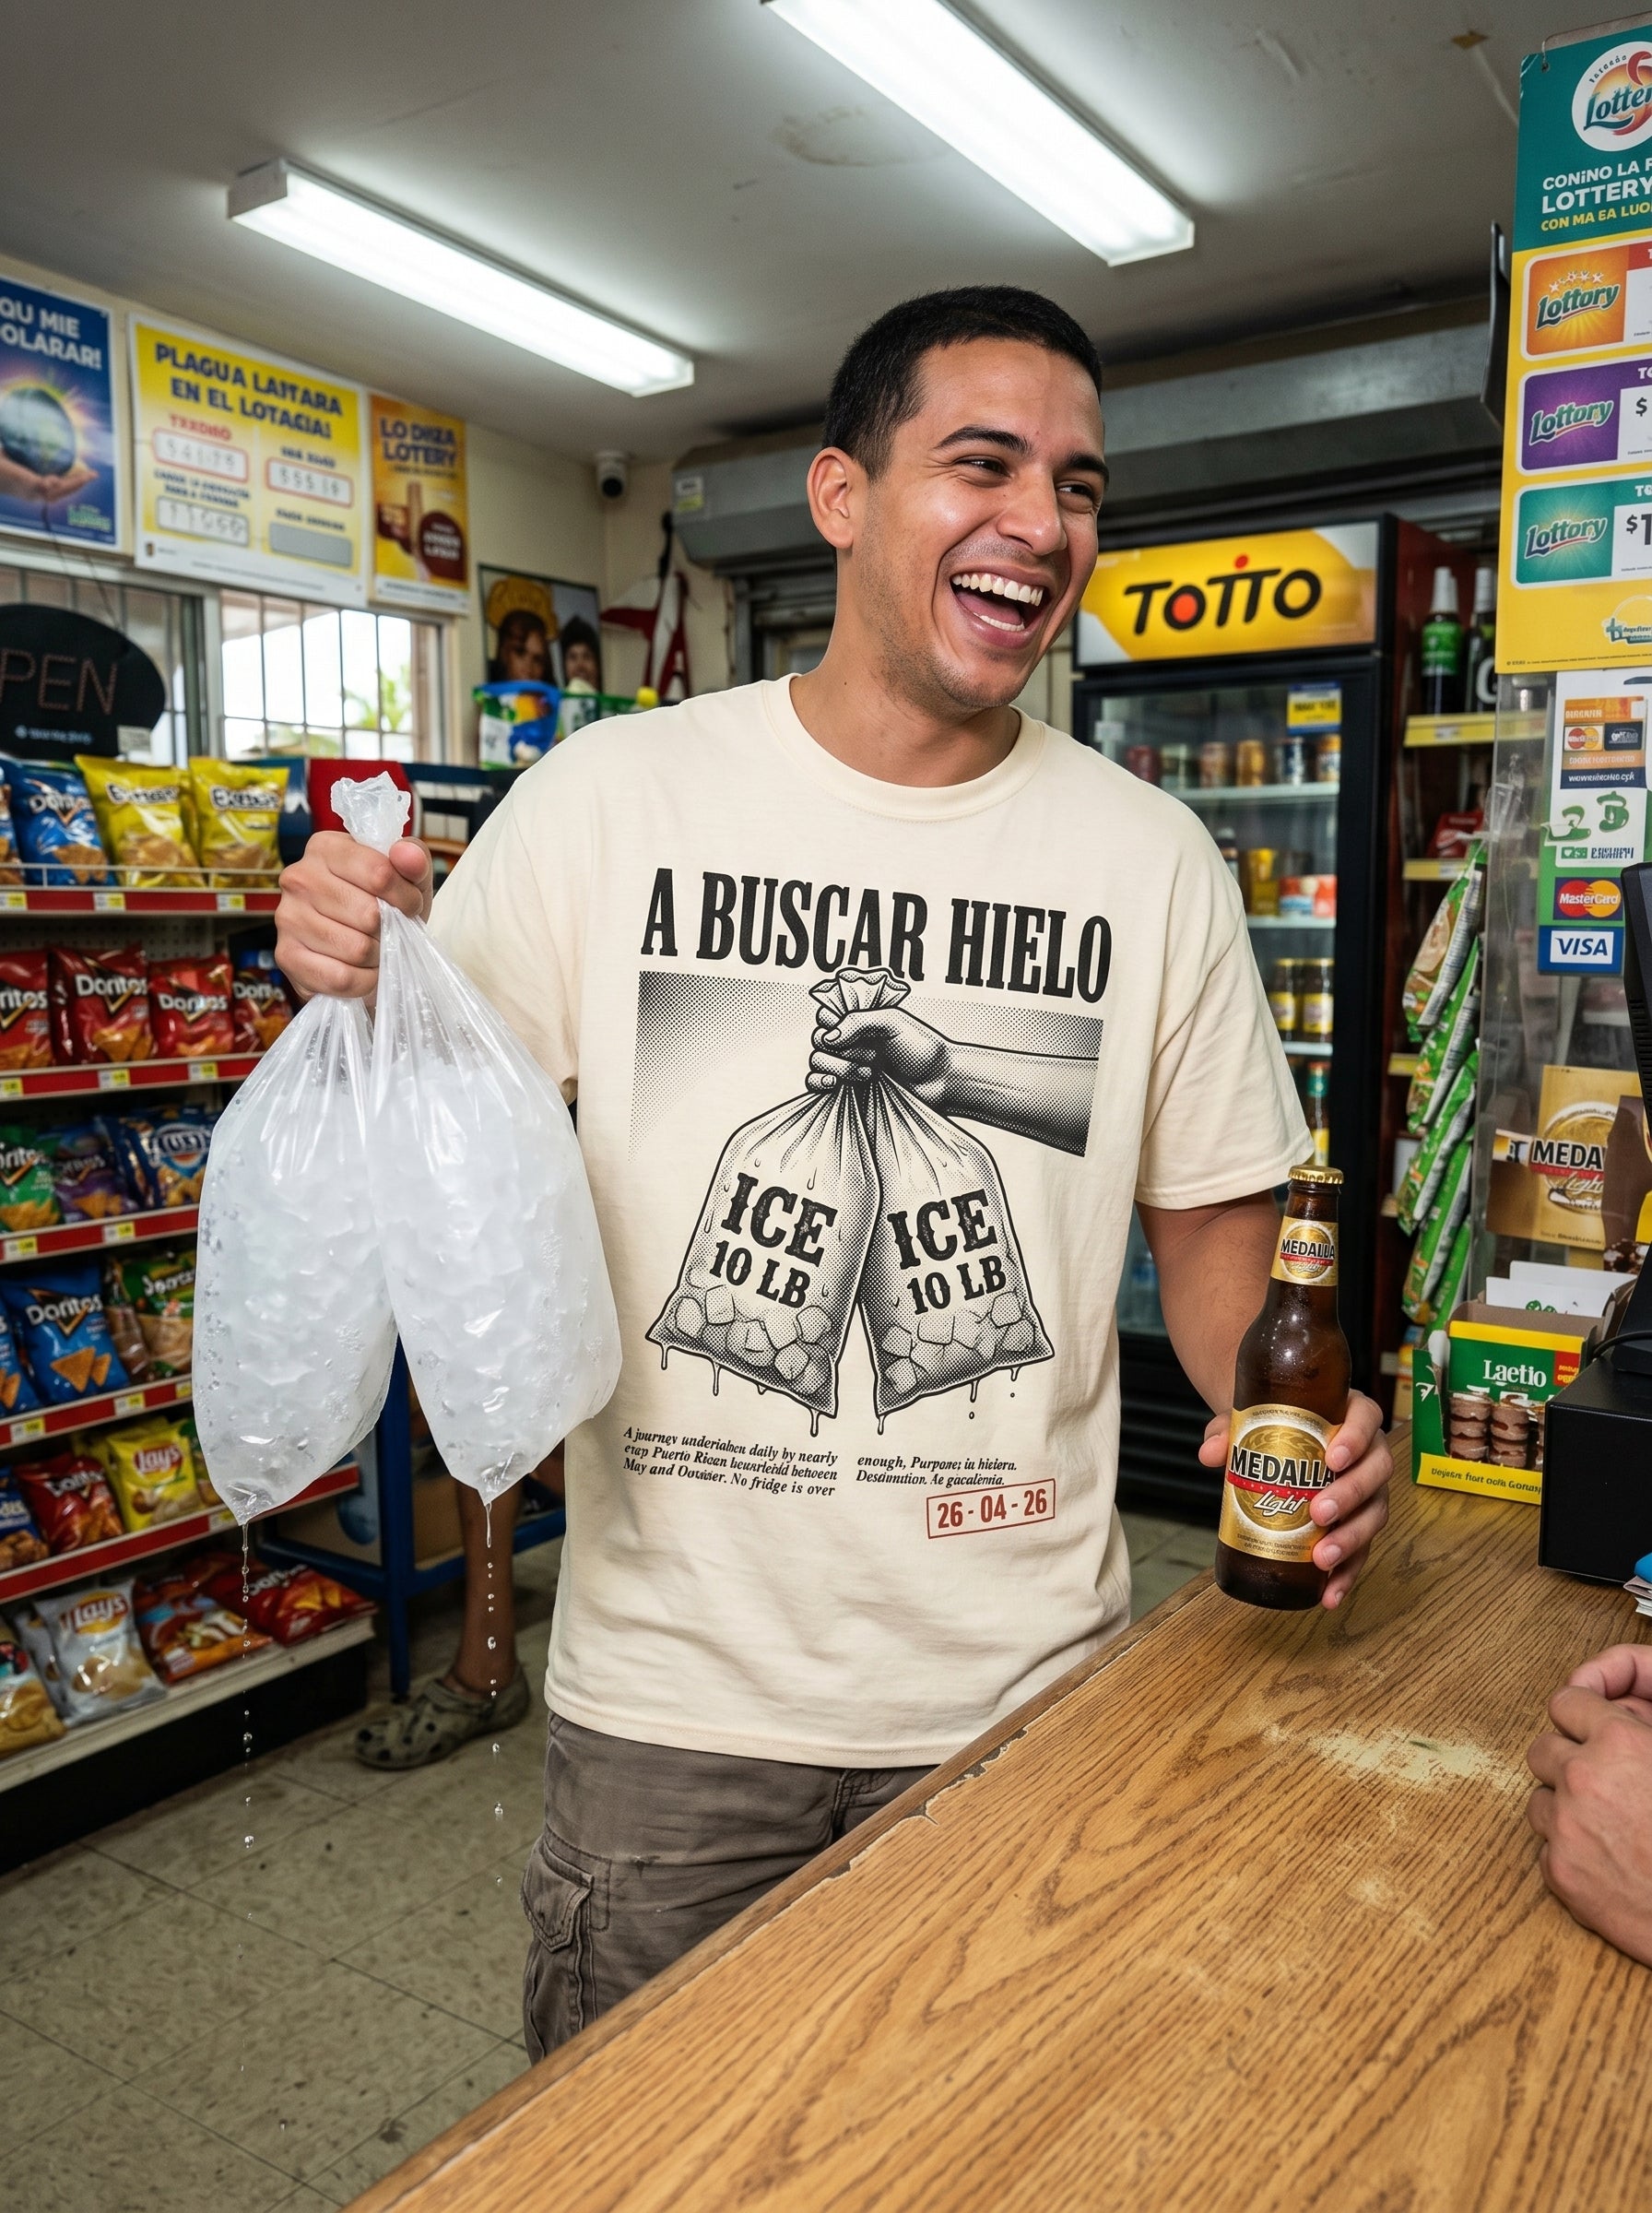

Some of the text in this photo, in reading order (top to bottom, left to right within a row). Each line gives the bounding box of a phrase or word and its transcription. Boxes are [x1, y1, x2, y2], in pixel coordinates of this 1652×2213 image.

[1617, 160, 1640, 177] LA
[1541, 175, 1652, 214] LOTTERY
[1540, 201, 1652, 231] CON MA EA LUO
[39, 307, 81, 340] MIE
[170, 376, 201, 404] EN
[207, 386, 234, 412] EL
[1123, 564, 1322, 636] TOTTO
[1559, 893, 1620, 905] MasterCard
[640, 867, 1112, 1003] A BUSCAR HIELO
[1554, 937, 1609, 956] VISA
[1533, 1140, 1603, 1170] MEDA
[720, 1172, 838, 1268] ICE
[887, 1188, 998, 1270] ICE
[709, 1240, 811, 1308] 10 LB
[906, 1255, 1007, 1315] 10 LB
[25, 1294, 103, 1326] Doritos
[623, 1426, 632, 1438] A
[749, 1443, 779, 1462] daily
[782, 1447, 796, 1463] by
[798, 1450, 839, 1467] nearly
[652, 1446, 691, 1462] Puerto
[857, 1455, 906, 1472] enough,
[623, 1457, 648, 1475] May
[649, 1463, 676, 1476] and
[730, 1473, 748, 1486] No
[749, 1476, 787, 1495] fridge
[791, 1481, 804, 1494] is
[807, 1485, 836, 1497] over
[1253, 1489, 1308, 1518] Light
